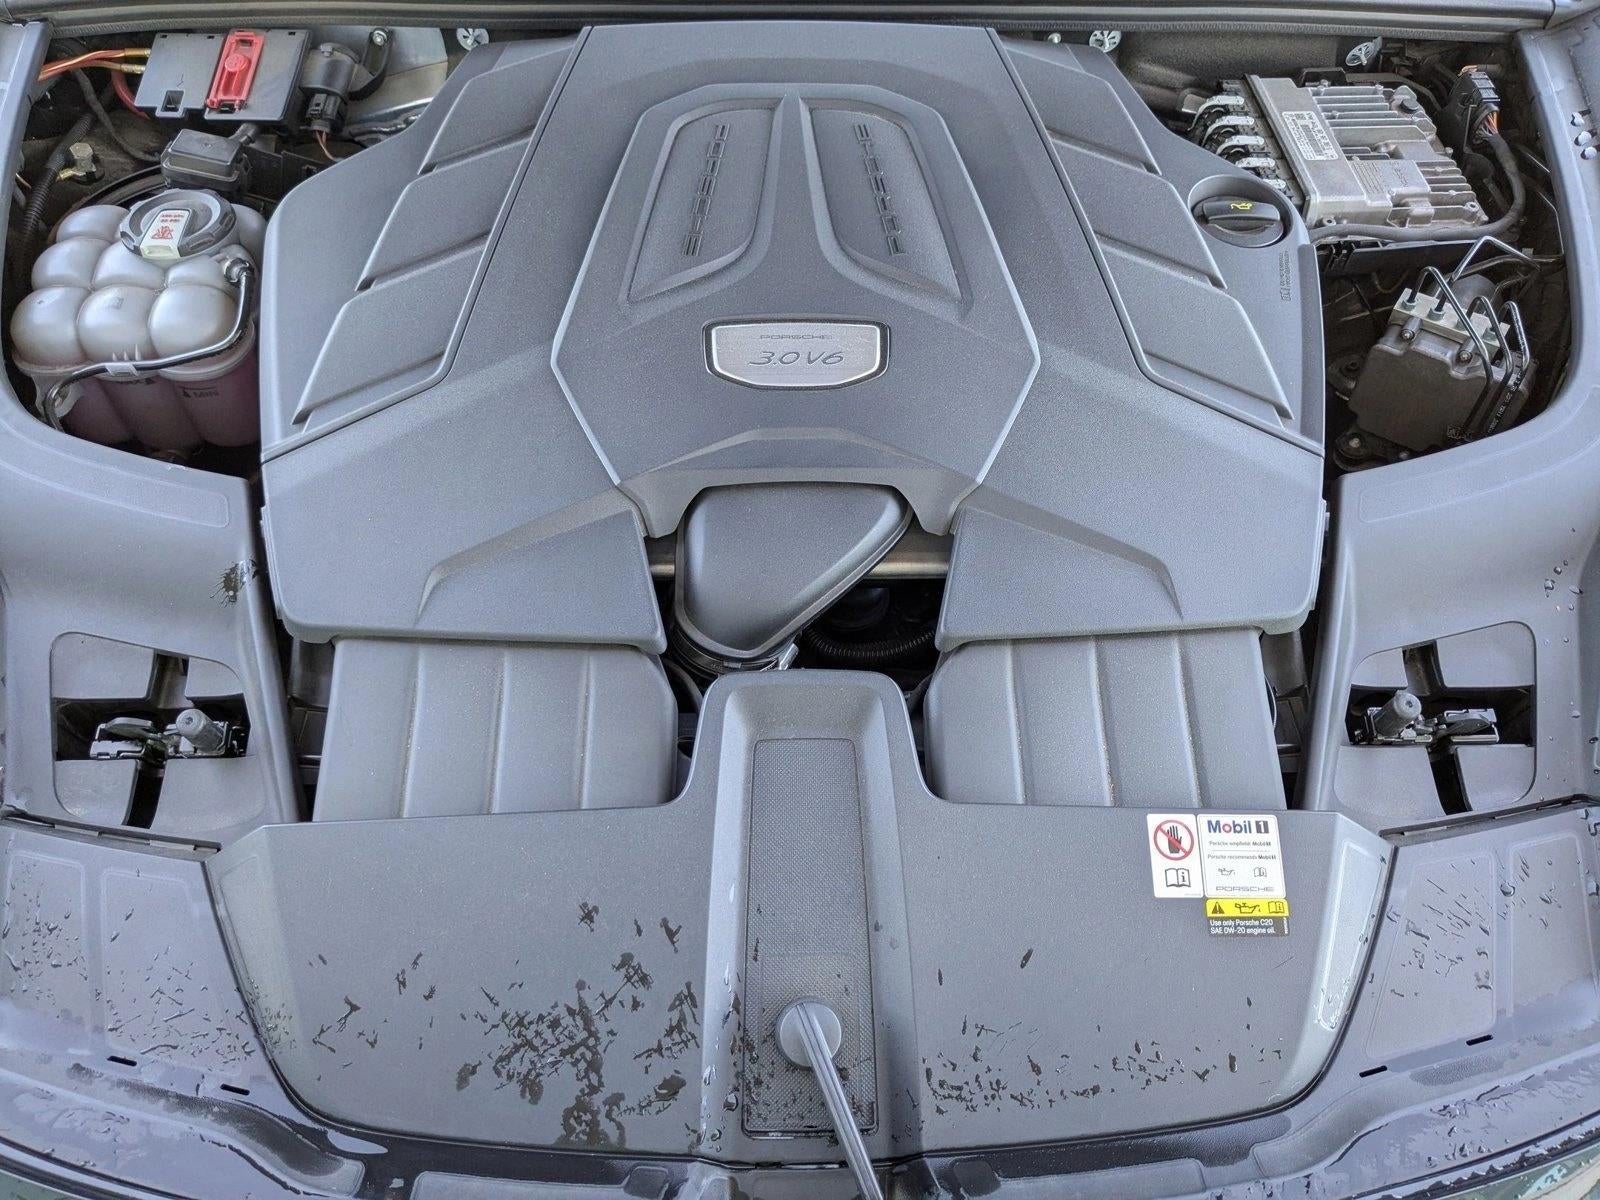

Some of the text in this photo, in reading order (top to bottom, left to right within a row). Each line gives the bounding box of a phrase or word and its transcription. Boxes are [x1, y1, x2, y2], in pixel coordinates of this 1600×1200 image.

[680, 124, 730, 257] PORSCHE
[853, 124, 906, 257] PORSCHE
[748, 351, 844, 365] 3.0 V6
[1207, 820, 1269, 834] Mobil 1
[1223, 919, 1235, 928] only
[1247, 927, 1266, 935] engine
